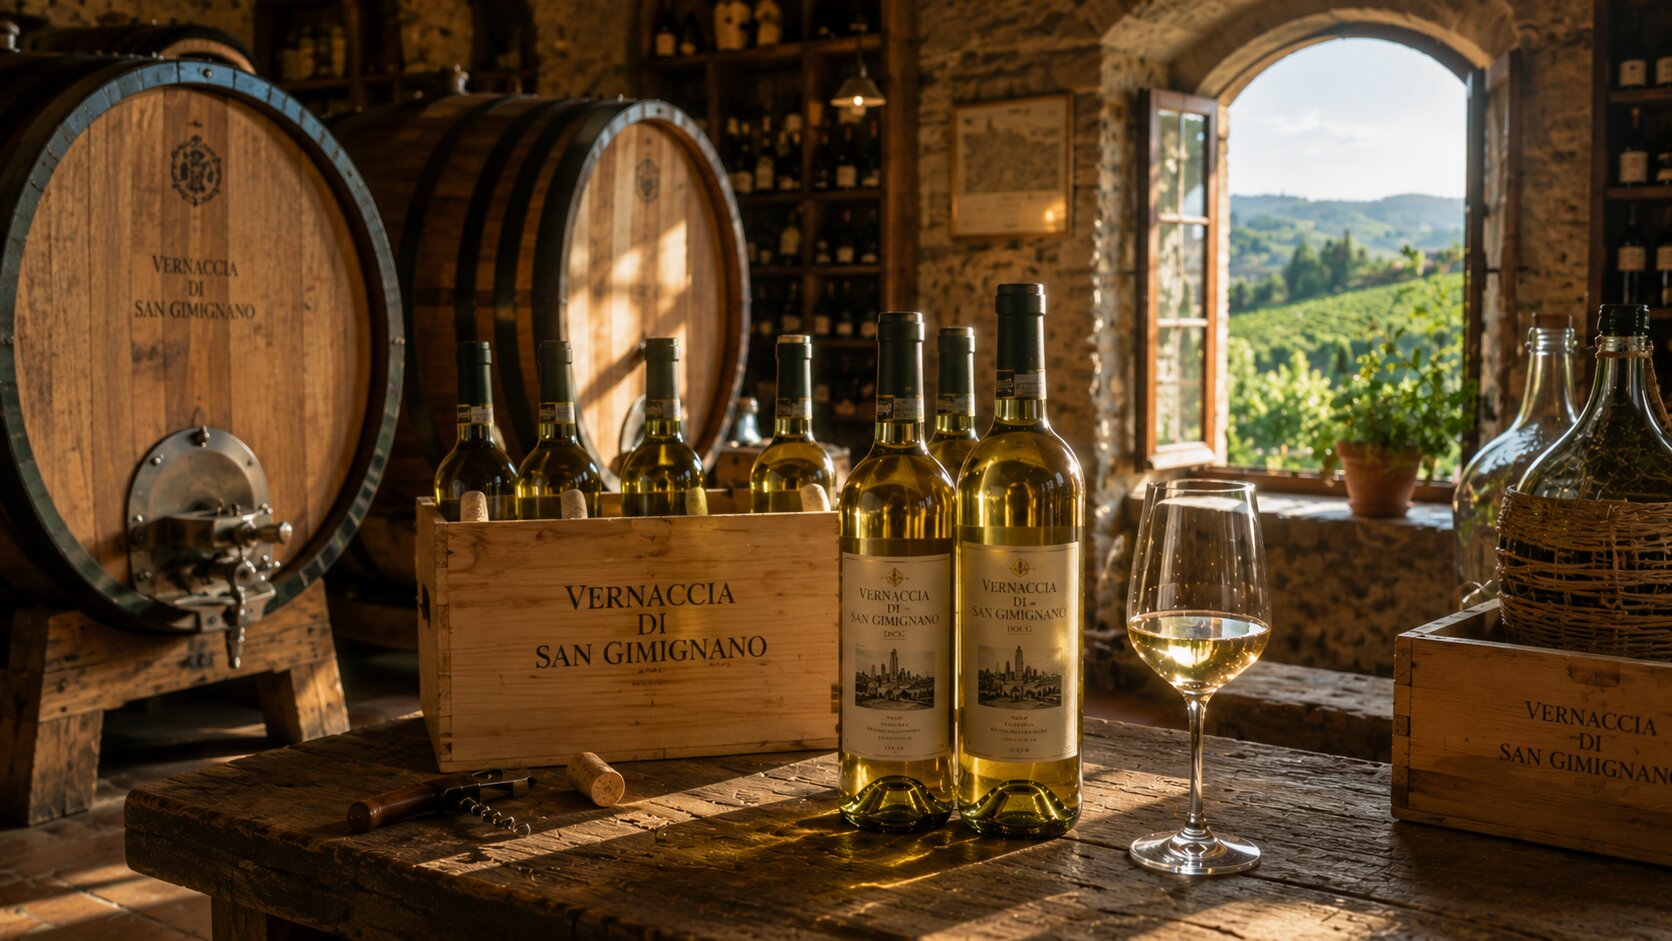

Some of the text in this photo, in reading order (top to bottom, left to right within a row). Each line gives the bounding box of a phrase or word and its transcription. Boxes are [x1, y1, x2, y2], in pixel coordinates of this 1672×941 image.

[152, 255, 238, 276] VERNACCIA
[188, 280, 204, 297] DI
[134, 300, 256, 320] SAN GIMIGNANO
[565, 582, 736, 610] VERNACCIA
[859, 587, 930, 602] VERNACCIA
[982, 579, 1057, 594] VERNACCIA
[887, 604, 900, 614] DI
[1013, 597, 1026, 607] DI
[850, 611, 940, 627] SAN GIMIGNANO
[972, 605, 1067, 621] SAN GIMIGNANO
[637, 612, 666, 635] DI
[536, 635, 767, 669] SAN GIMIGNANO
[1525, 700, 1657, 736] VERNACCIA
[1579, 733, 1602, 752] DI
[1499, 743, 1542, 766] SAN
